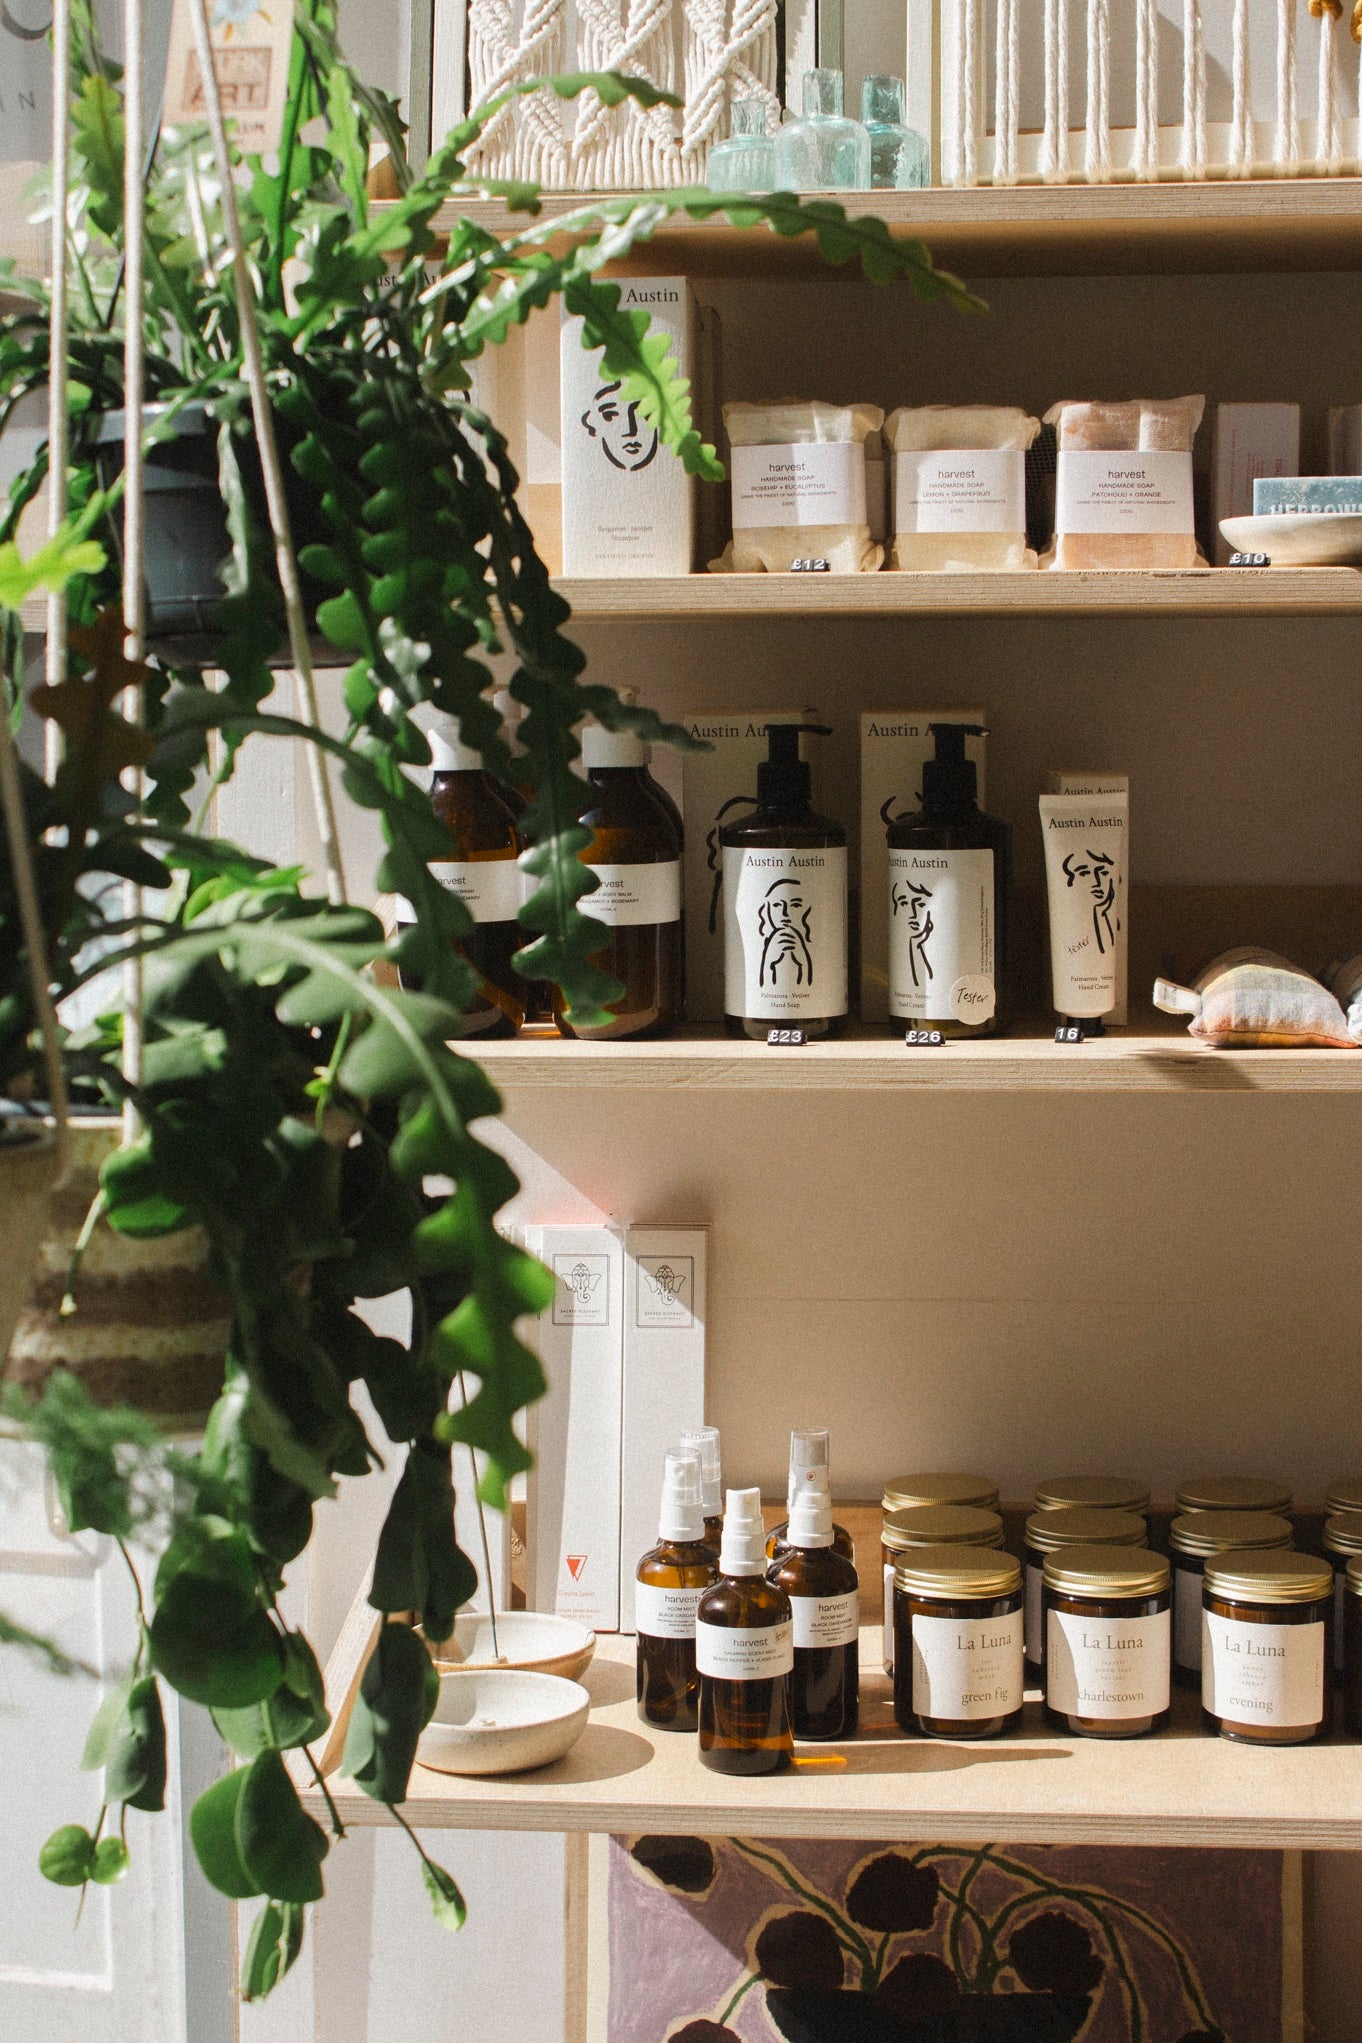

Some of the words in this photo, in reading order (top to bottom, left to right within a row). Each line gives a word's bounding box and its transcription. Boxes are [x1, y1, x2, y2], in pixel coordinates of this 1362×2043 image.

[626, 288, 679, 302] Austin
[769, 462, 806, 472] harvest
[938, 470, 975, 478] harvest
[1108, 470, 1146, 479] harvest
[791, 559, 826, 570] £12
[1229, 553, 1265, 564] £10
[690, 724, 739, 737] Austin
[868, 722, 919, 736] Austin
[1049, 817, 1085, 829] Austin
[1089, 816, 1123, 828] Austin
[746, 856, 783, 867] Austin
[788, 856, 825, 867] Austin
[911, 857, 948, 868] Austin
[957, 987, 989, 1004] Tester
[768, 1030, 802, 1042] £23
[905, 1030, 941, 1043] £26
[1057, 1028, 1078, 1039] 16
[664, 1595, 698, 1603] harvest
[818, 1602, 848, 1612] harvest
[733, 1638, 768, 1647] harvest
[957, 1636, 975, 1650] La
[980, 1635, 1012, 1649] Luna
[1083, 1634, 1100, 1649] La
[1107, 1635, 1143, 1650] Luna
[1225, 1636, 1241, 1653] La
[1247, 1640, 1286, 1657] Luna
[961, 1693, 991, 1706] green
[994, 1687, 1008, 1702] fig
[1077, 1689, 1144, 1702] charlestown
[1230, 1697, 1274, 1712] evening
